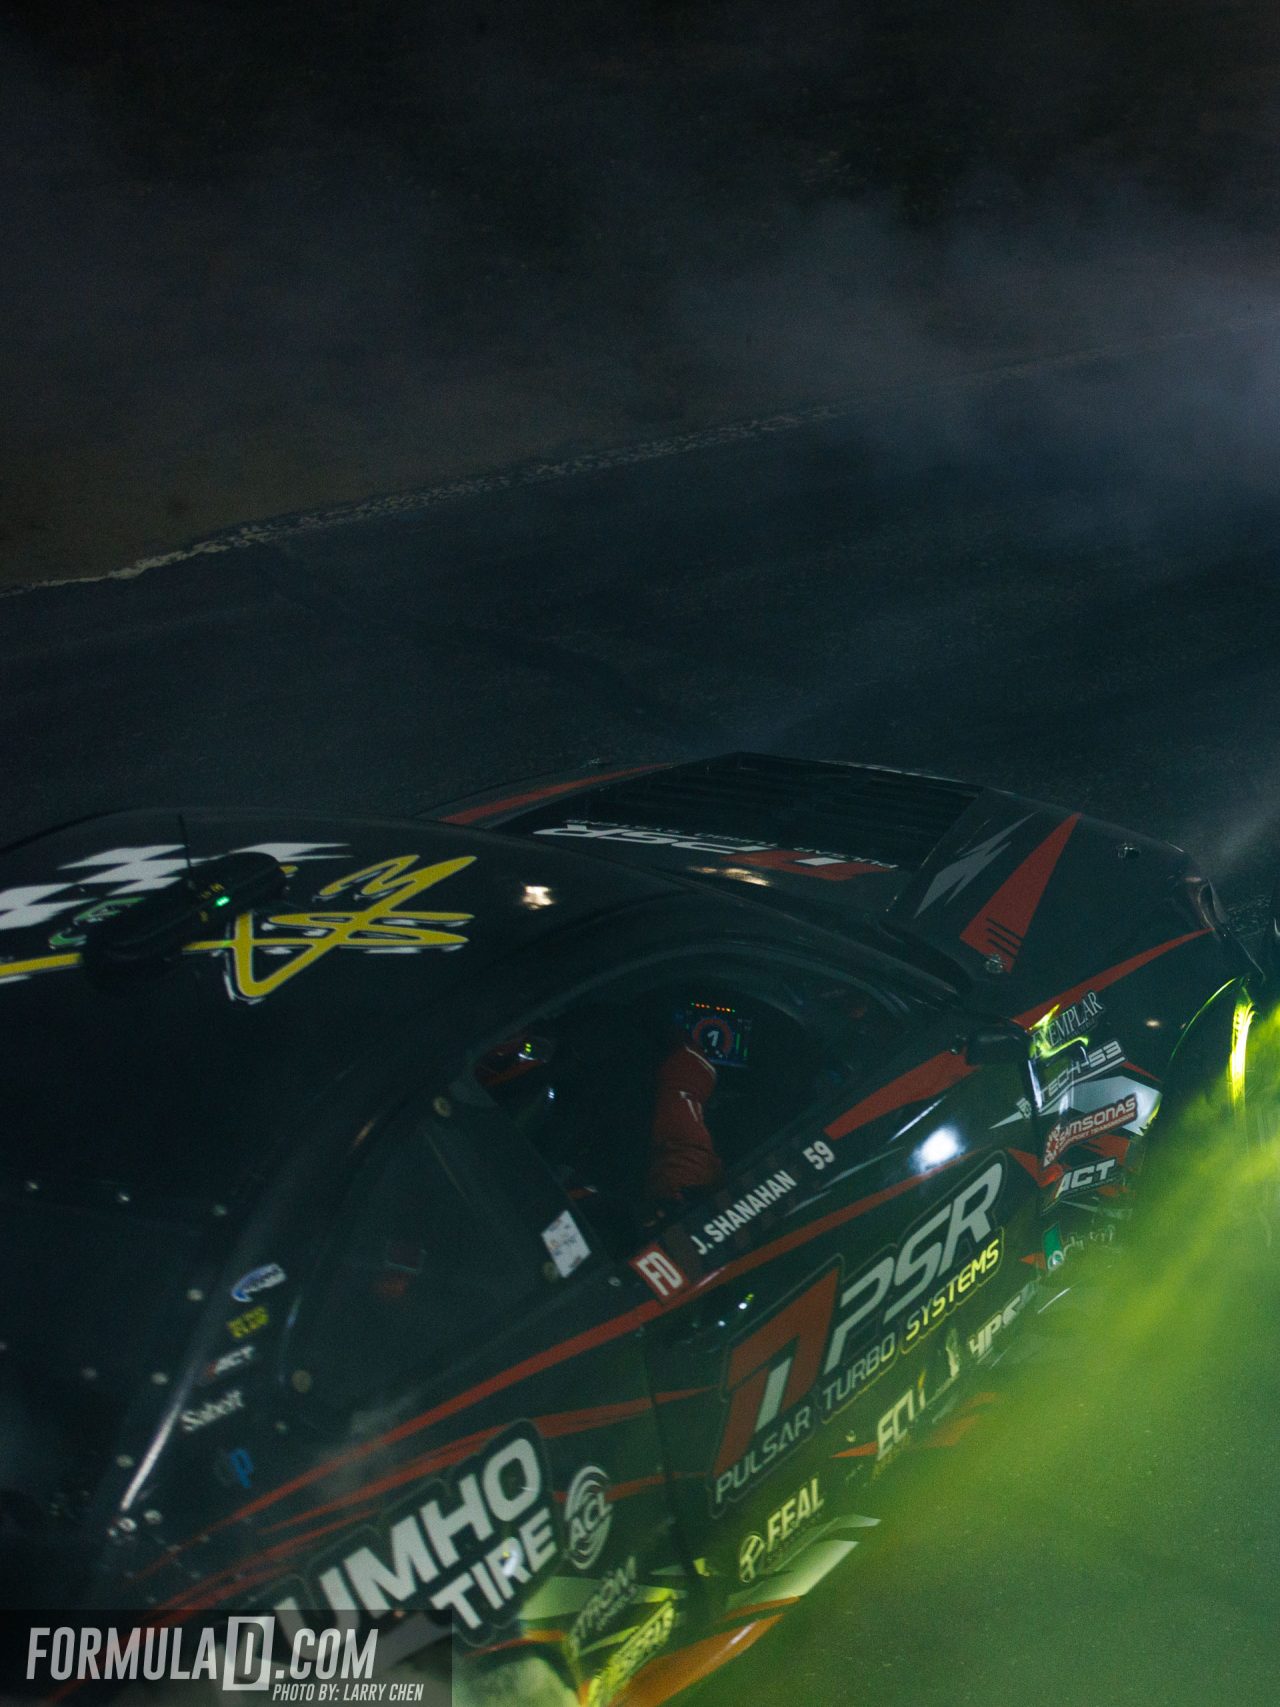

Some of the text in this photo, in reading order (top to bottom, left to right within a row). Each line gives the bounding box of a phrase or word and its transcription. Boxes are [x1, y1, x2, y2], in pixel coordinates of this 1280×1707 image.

[703, 1169, 798, 1243] SHANAHAN
[802, 1140, 836, 1171] 59
[823, 1162, 1003, 1376] PSR
[715, 1405, 811, 1504] PULSAR
[822, 1331, 896, 1411] TURBO
[906, 1238, 1000, 1342] SYSTEMS
[272, 1437, 542, 1662] UMHO
[430, 1507, 557, 1631] TIRE
[766, 1477, 825, 1553] FEAL
